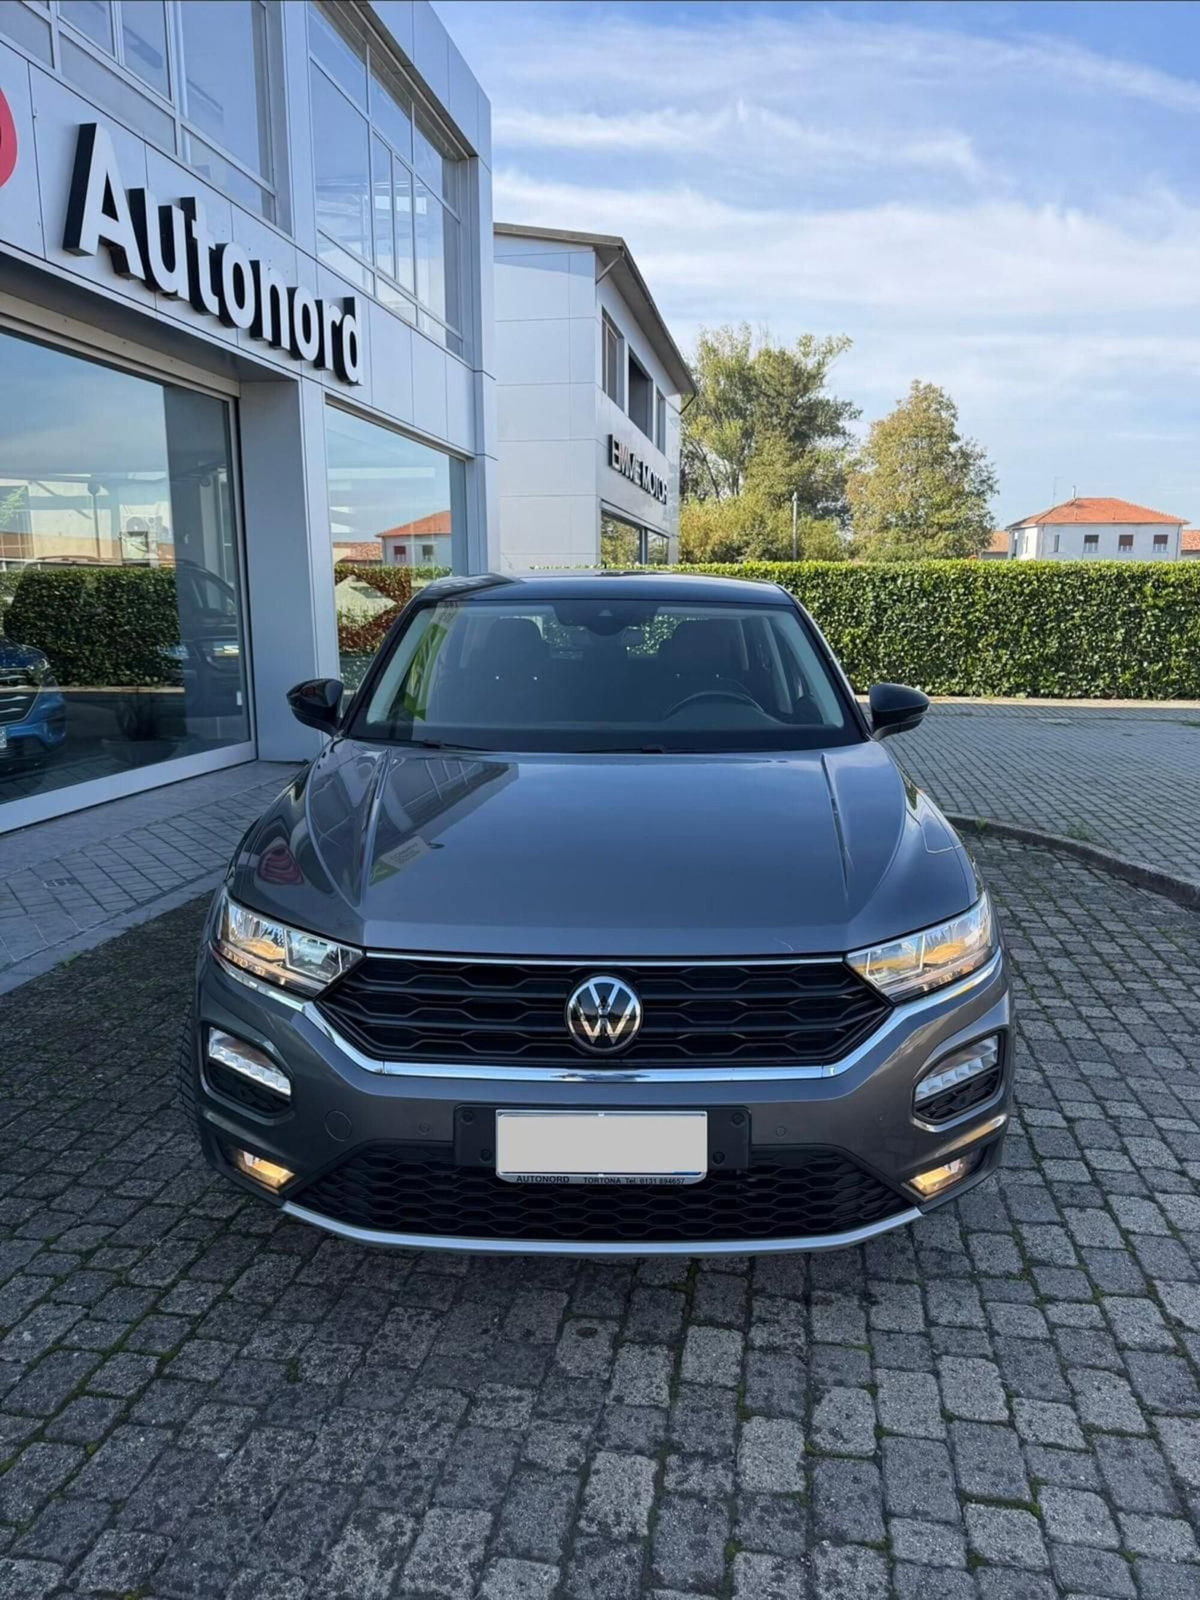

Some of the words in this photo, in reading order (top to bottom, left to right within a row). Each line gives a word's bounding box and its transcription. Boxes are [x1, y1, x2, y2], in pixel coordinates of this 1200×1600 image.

[63, 123, 362, 385] Autonord
[567, 977, 640, 1048] VW
[516, 1175, 570, 1184] AUTONORD
